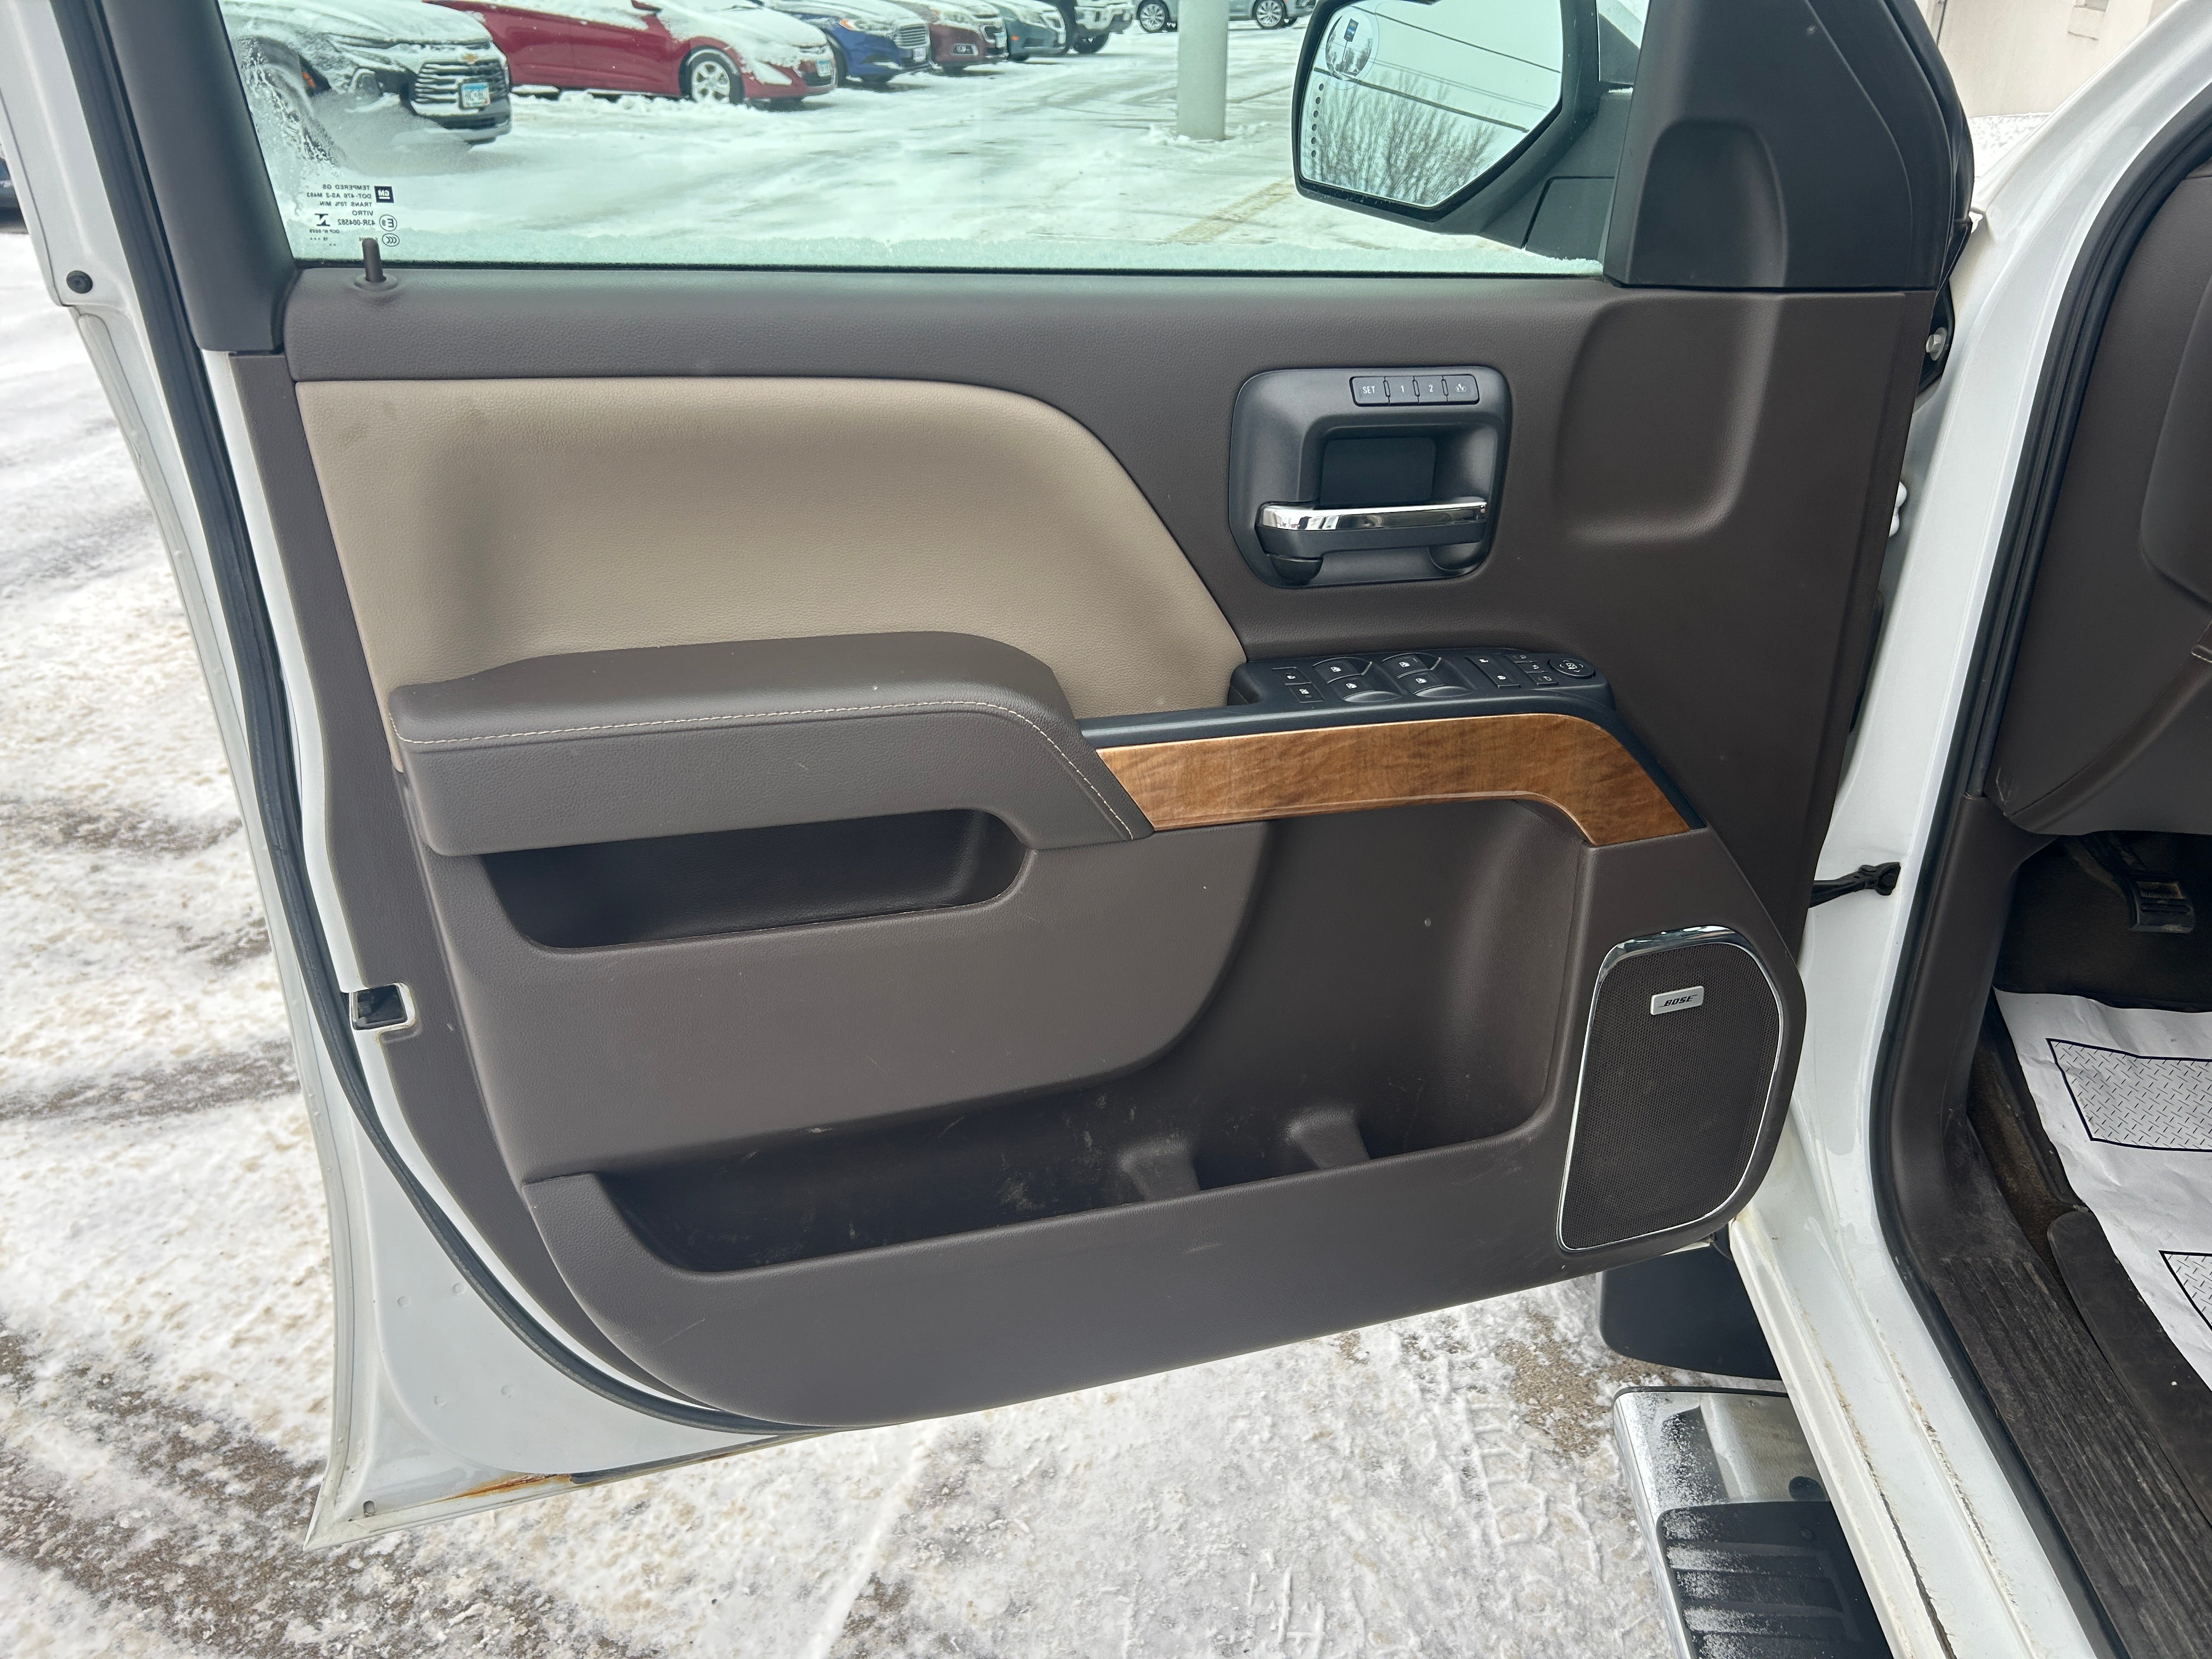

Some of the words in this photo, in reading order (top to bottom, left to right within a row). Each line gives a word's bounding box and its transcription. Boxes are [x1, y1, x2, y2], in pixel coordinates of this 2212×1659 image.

[1362, 386, 1375, 394] SET
[1401, 385, 1404, 393] 1
[1660, 995, 1696, 1007] BOSE
